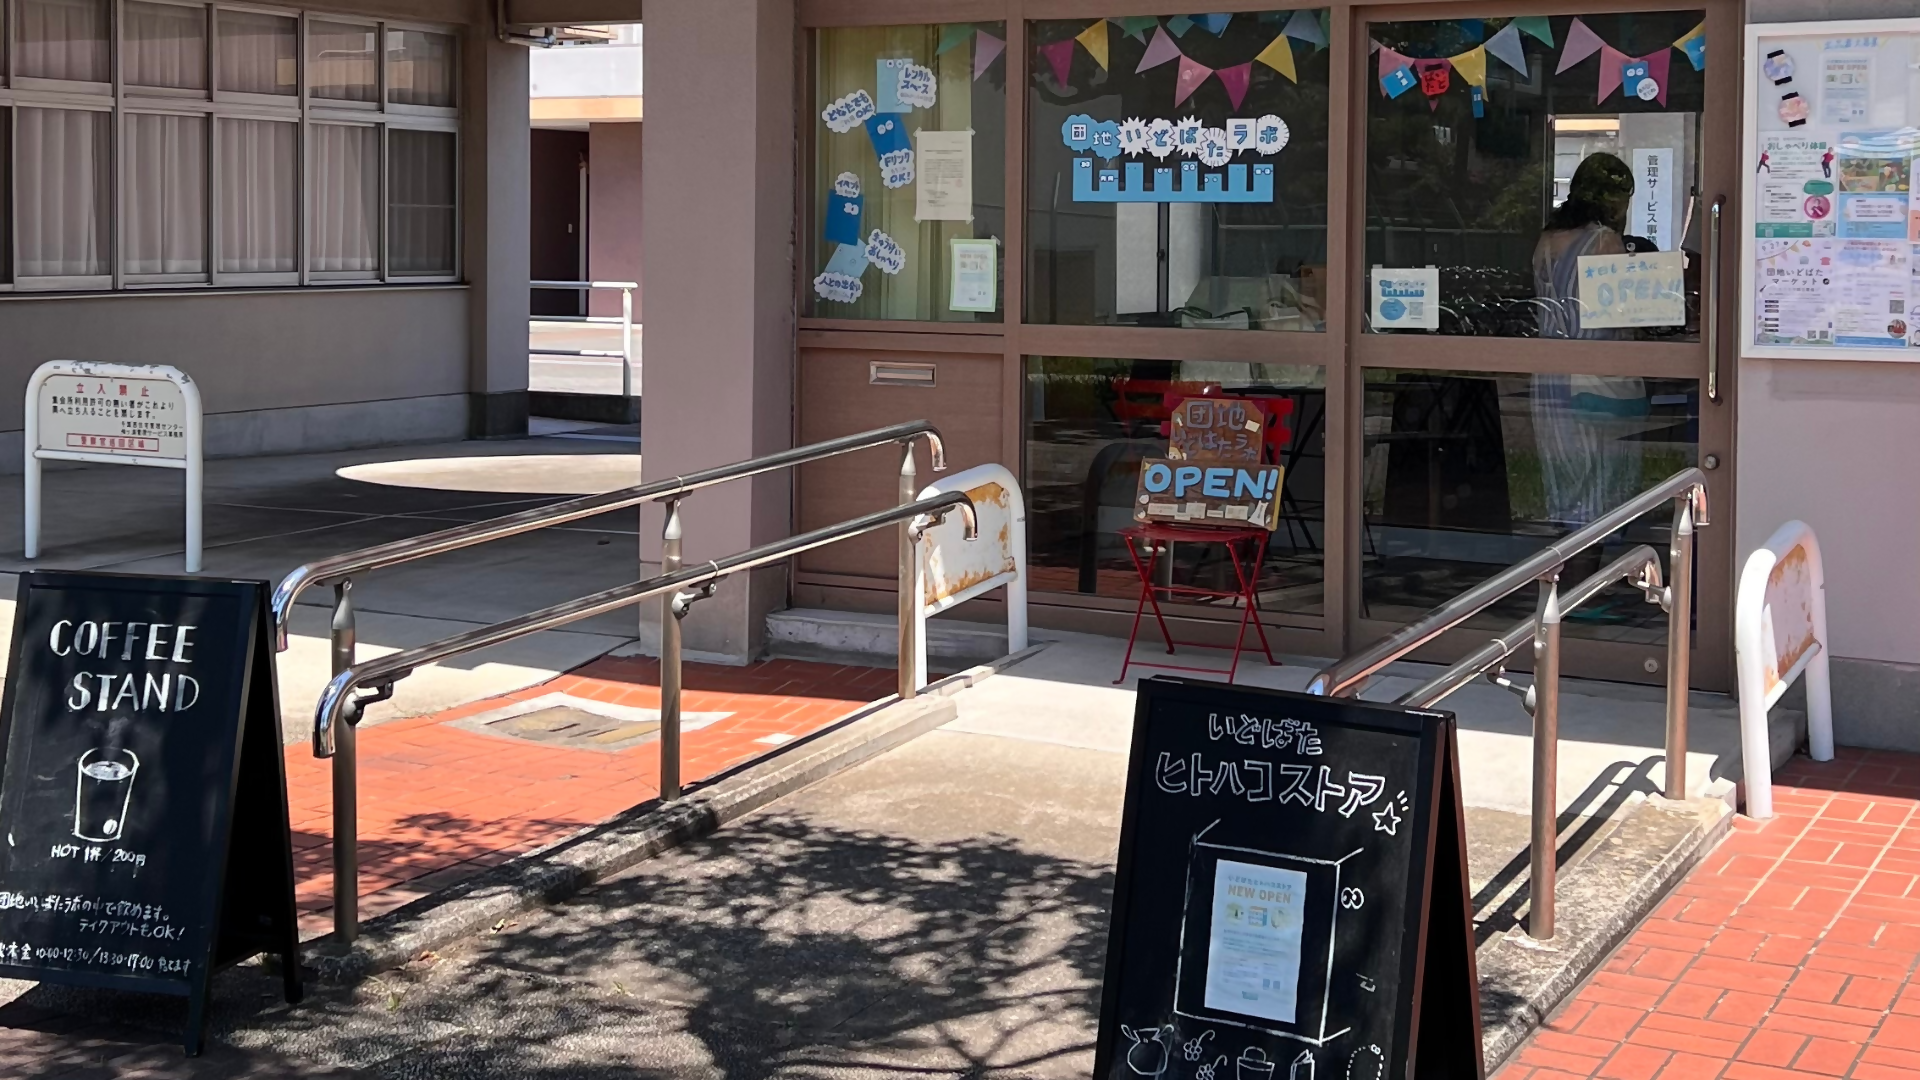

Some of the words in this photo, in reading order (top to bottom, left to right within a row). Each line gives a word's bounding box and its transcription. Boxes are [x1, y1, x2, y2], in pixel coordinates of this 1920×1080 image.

[1070, 123, 1279, 158] 団地いどばたラボ
[75, 382, 150, 397] 立入禁止
[1186, 401, 1246, 431] 団地
[1144, 463, 1279, 500] OPEN!
[49, 619, 199, 663] COFFEE
[68, 671, 200, 712] STAND
[1208, 713, 1323, 756] いどばた
[1155, 752, 1386, 818] ヒトハコストア
[51, 844, 80, 859] HOT
[1227, 884, 1256, 899] NEW
[1259, 889, 1292, 904] OPEN
